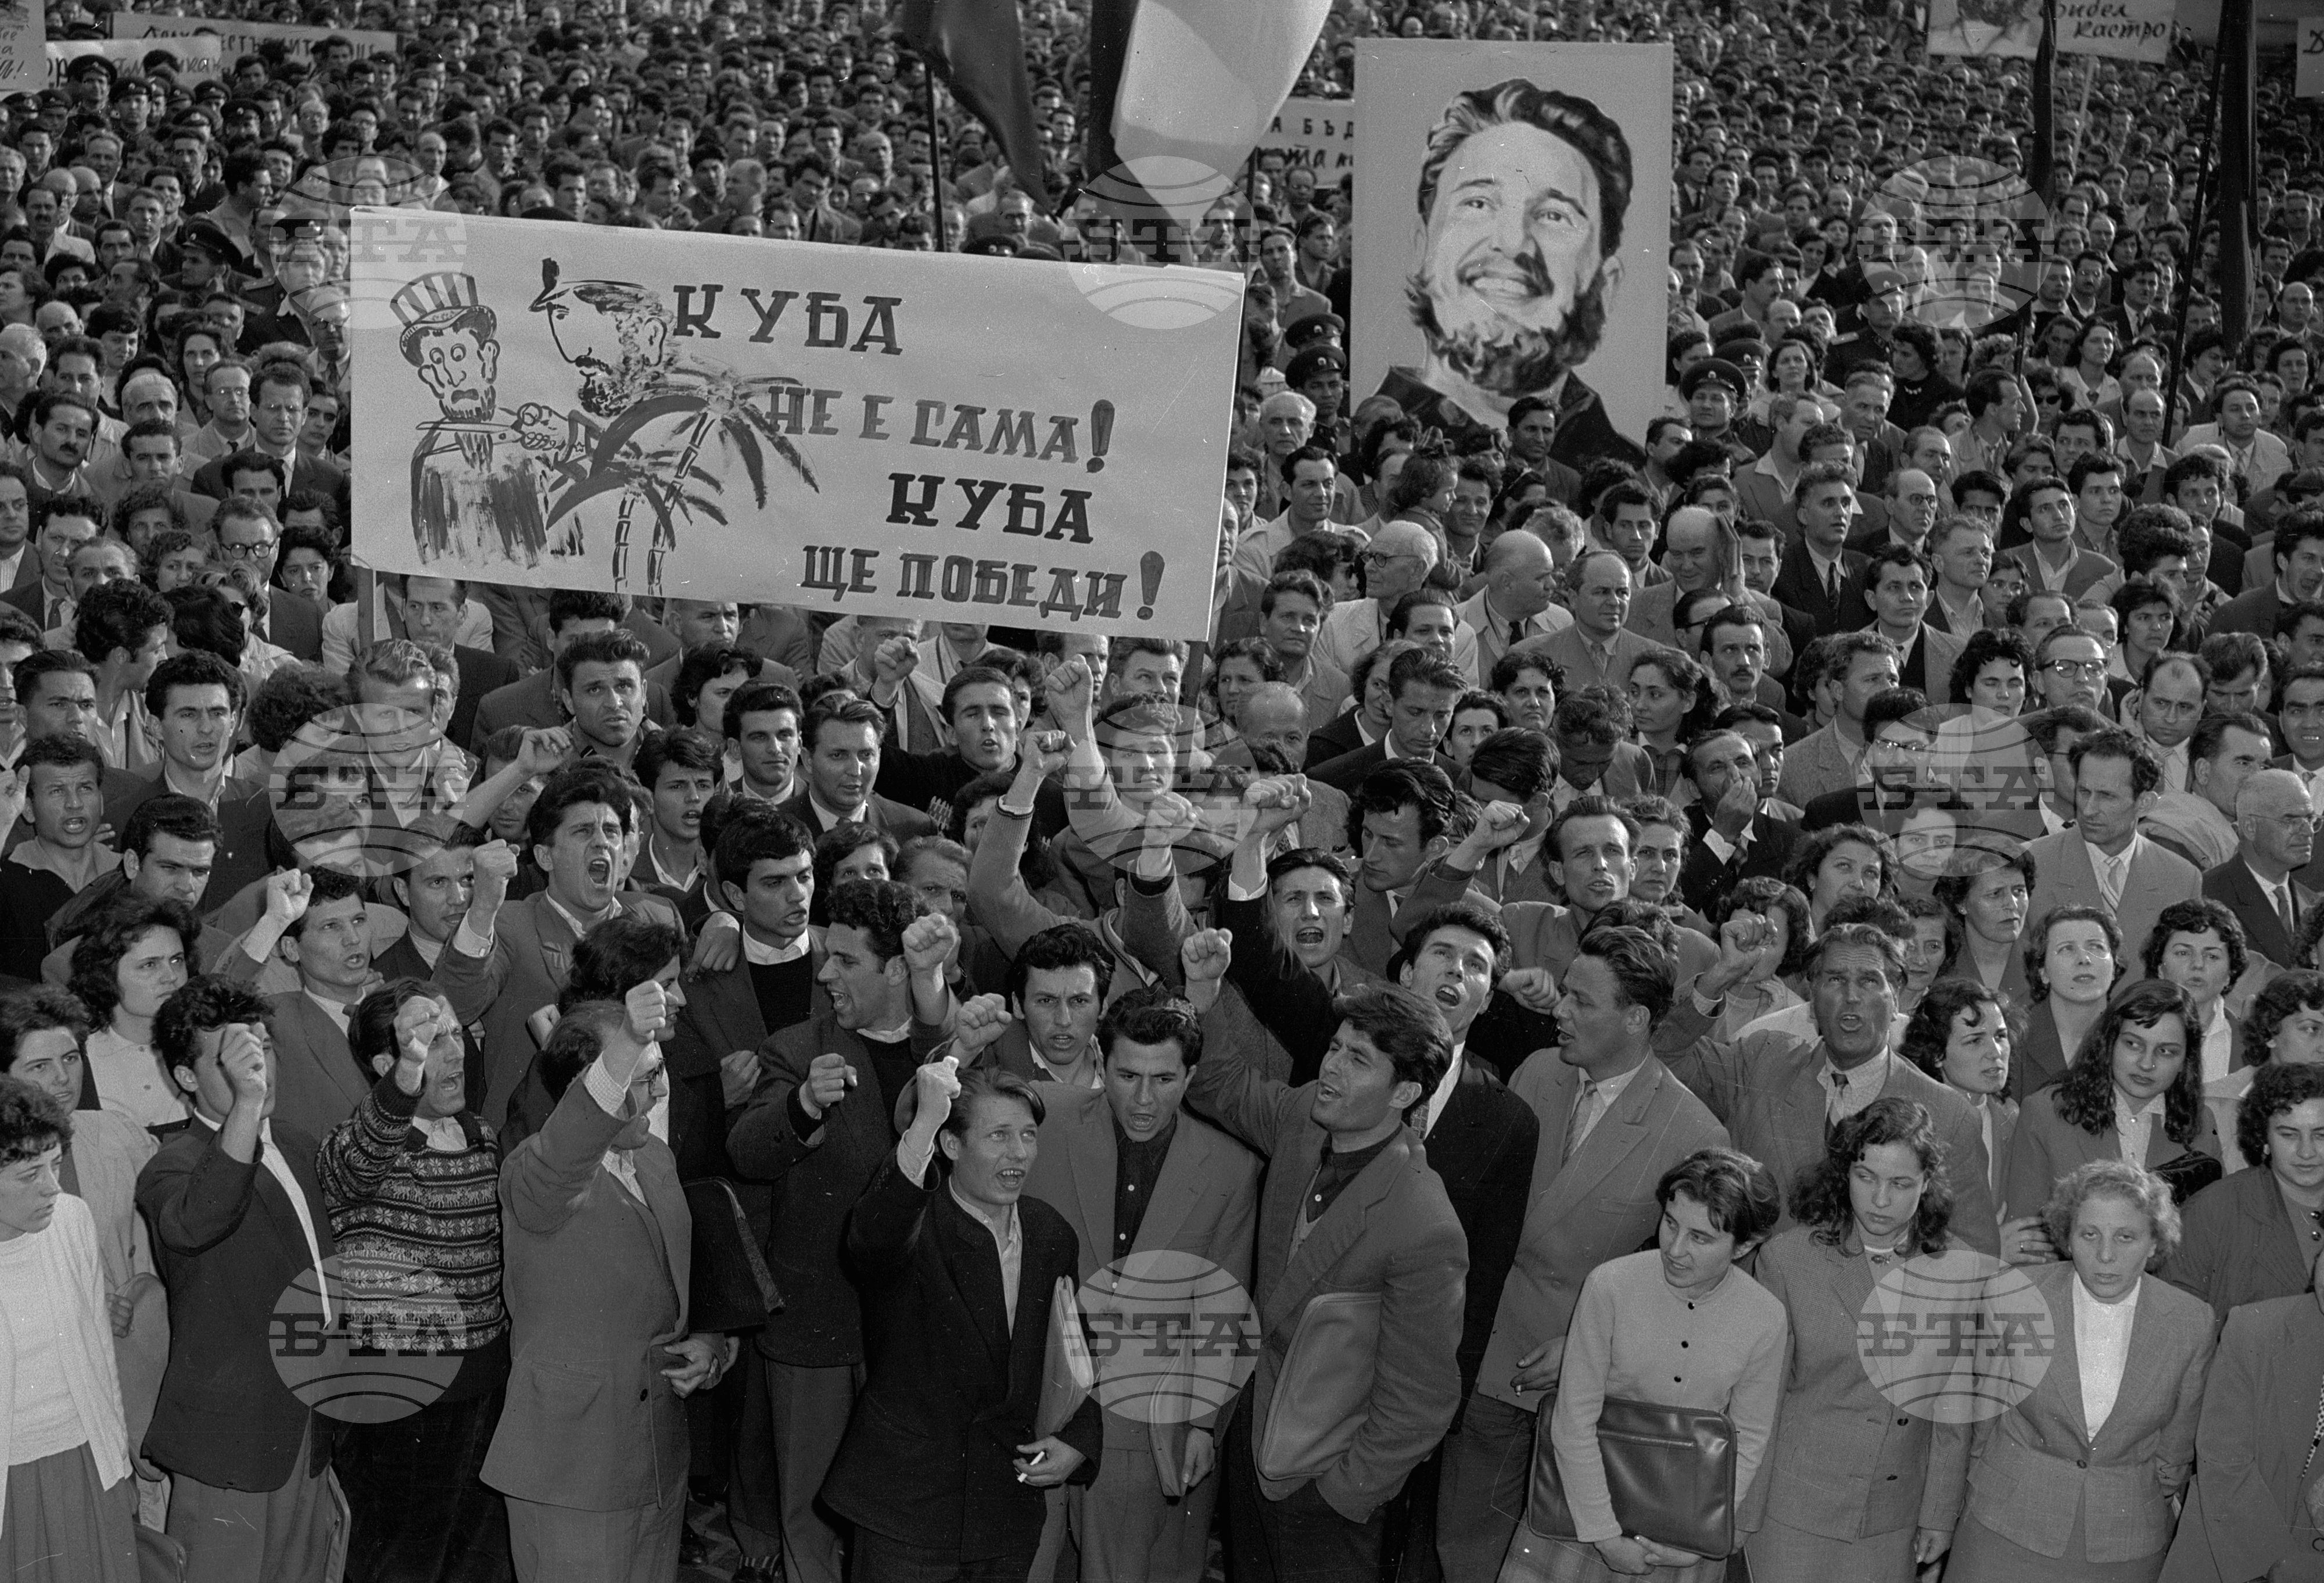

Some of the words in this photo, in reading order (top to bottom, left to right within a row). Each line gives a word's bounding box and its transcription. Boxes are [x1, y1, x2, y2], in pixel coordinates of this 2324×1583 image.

[2072, 19, 2166, 48] Кастро
[673, 284, 903, 356] КУБА
[765, 385, 843, 436] НЕ
[858, 393, 895, 440] Е
[909, 399, 1116, 473] САМА!
[885, 472, 1093, 544] КУБА
[800, 545, 880, 602] ЩЕ
[896, 550, 1165, 621] ПОБЕДИ!
